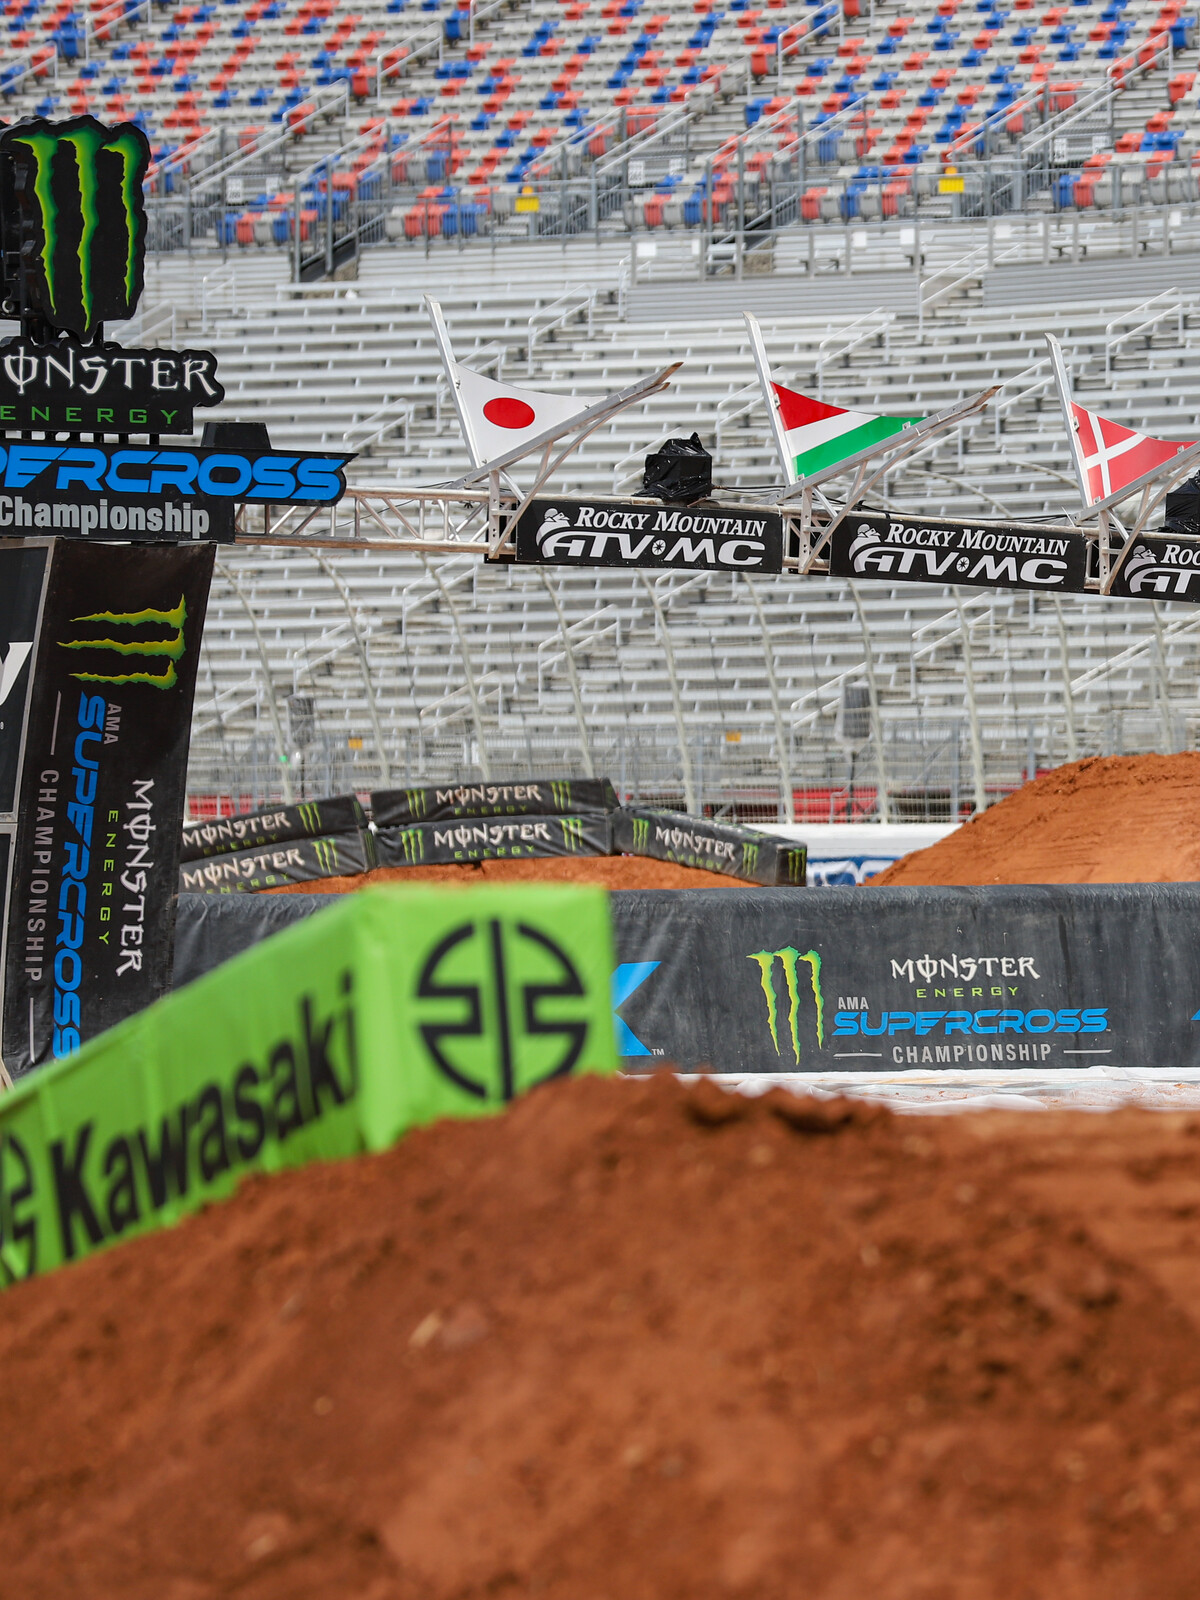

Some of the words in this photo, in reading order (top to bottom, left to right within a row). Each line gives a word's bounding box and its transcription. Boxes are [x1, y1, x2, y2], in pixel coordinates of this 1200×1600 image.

[0, 405, 178, 424] ENERGY
[0, 444, 345, 500] ERCROSS
[0, 495, 210, 539] Championship
[574, 507, 650, 530] ROCKY
[652, 511, 767, 537] MOUNTAIN
[885, 523, 957, 547] ROCKY
[957, 528, 1070, 556] MOUNTAIN
[103, 703, 122, 745] AMA
[24, 769, 59, 981] CHAMPIONSHIP
[53, 691, 107, 1060] SUPERCROSS
[98, 810, 119, 944] ENERGY
[838, 997, 869, 1010] AMA
[916, 986, 1020, 998] ENERGY
[832, 1008, 1109, 1036] SUPERCROSS
[892, 1044, 1052, 1064] CHAMPIONSHIP
[49, 970, 360, 1260] Kawasaki
